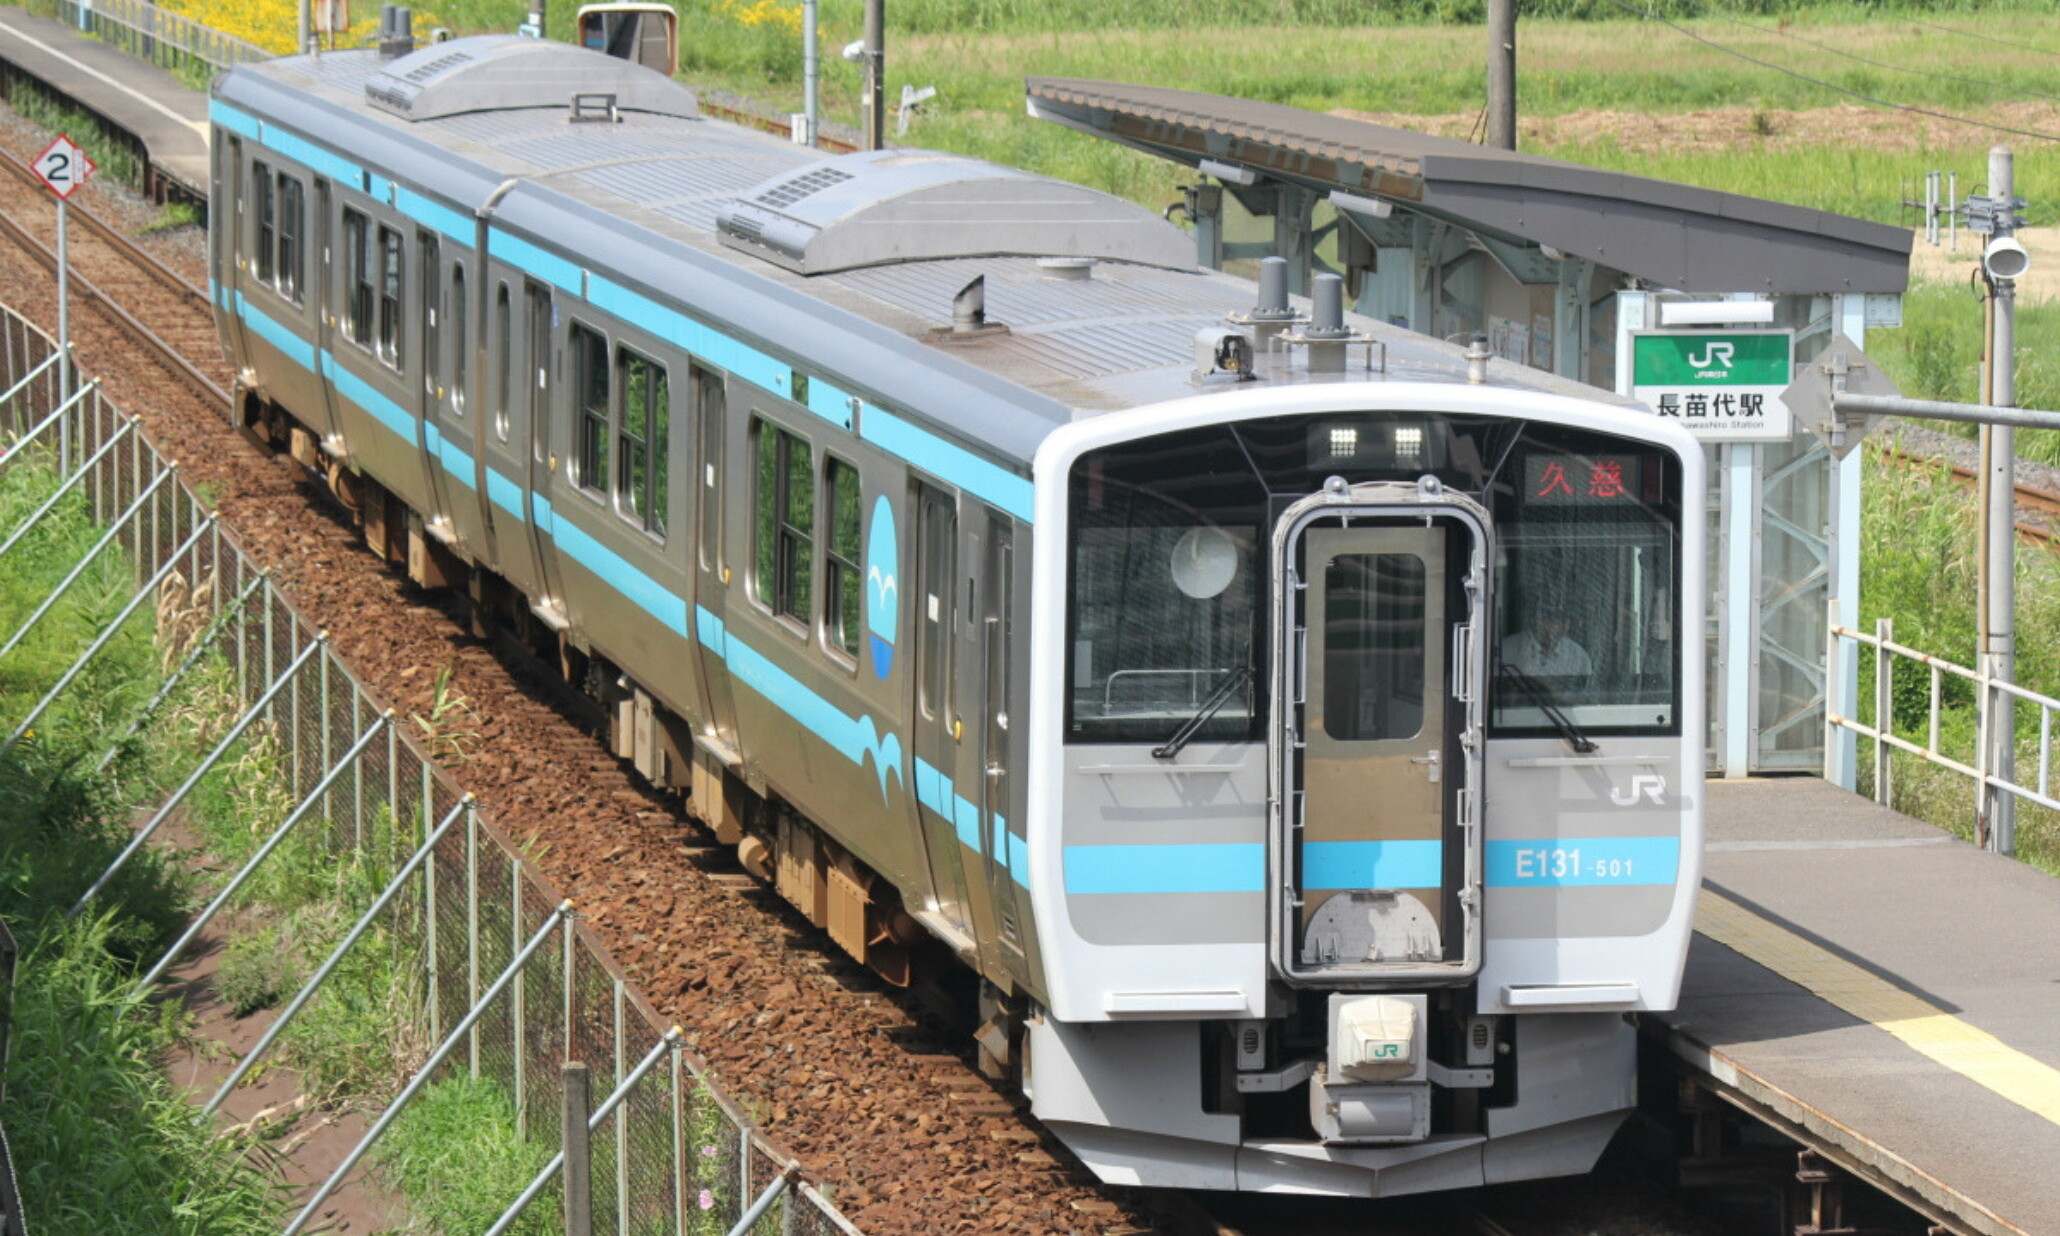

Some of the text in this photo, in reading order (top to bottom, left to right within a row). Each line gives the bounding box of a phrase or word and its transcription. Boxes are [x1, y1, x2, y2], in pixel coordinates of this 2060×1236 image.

[47, 153, 69, 180] 2
[1689, 341, 1735, 368] JR
[1657, 393, 1764, 417] 長苗代駅
[1731, 421, 1764, 429] Station
[1537, 461, 1625, 497] 久慈
[1611, 774, 1666, 806] JR
[1374, 1044, 1399, 1058] JR
